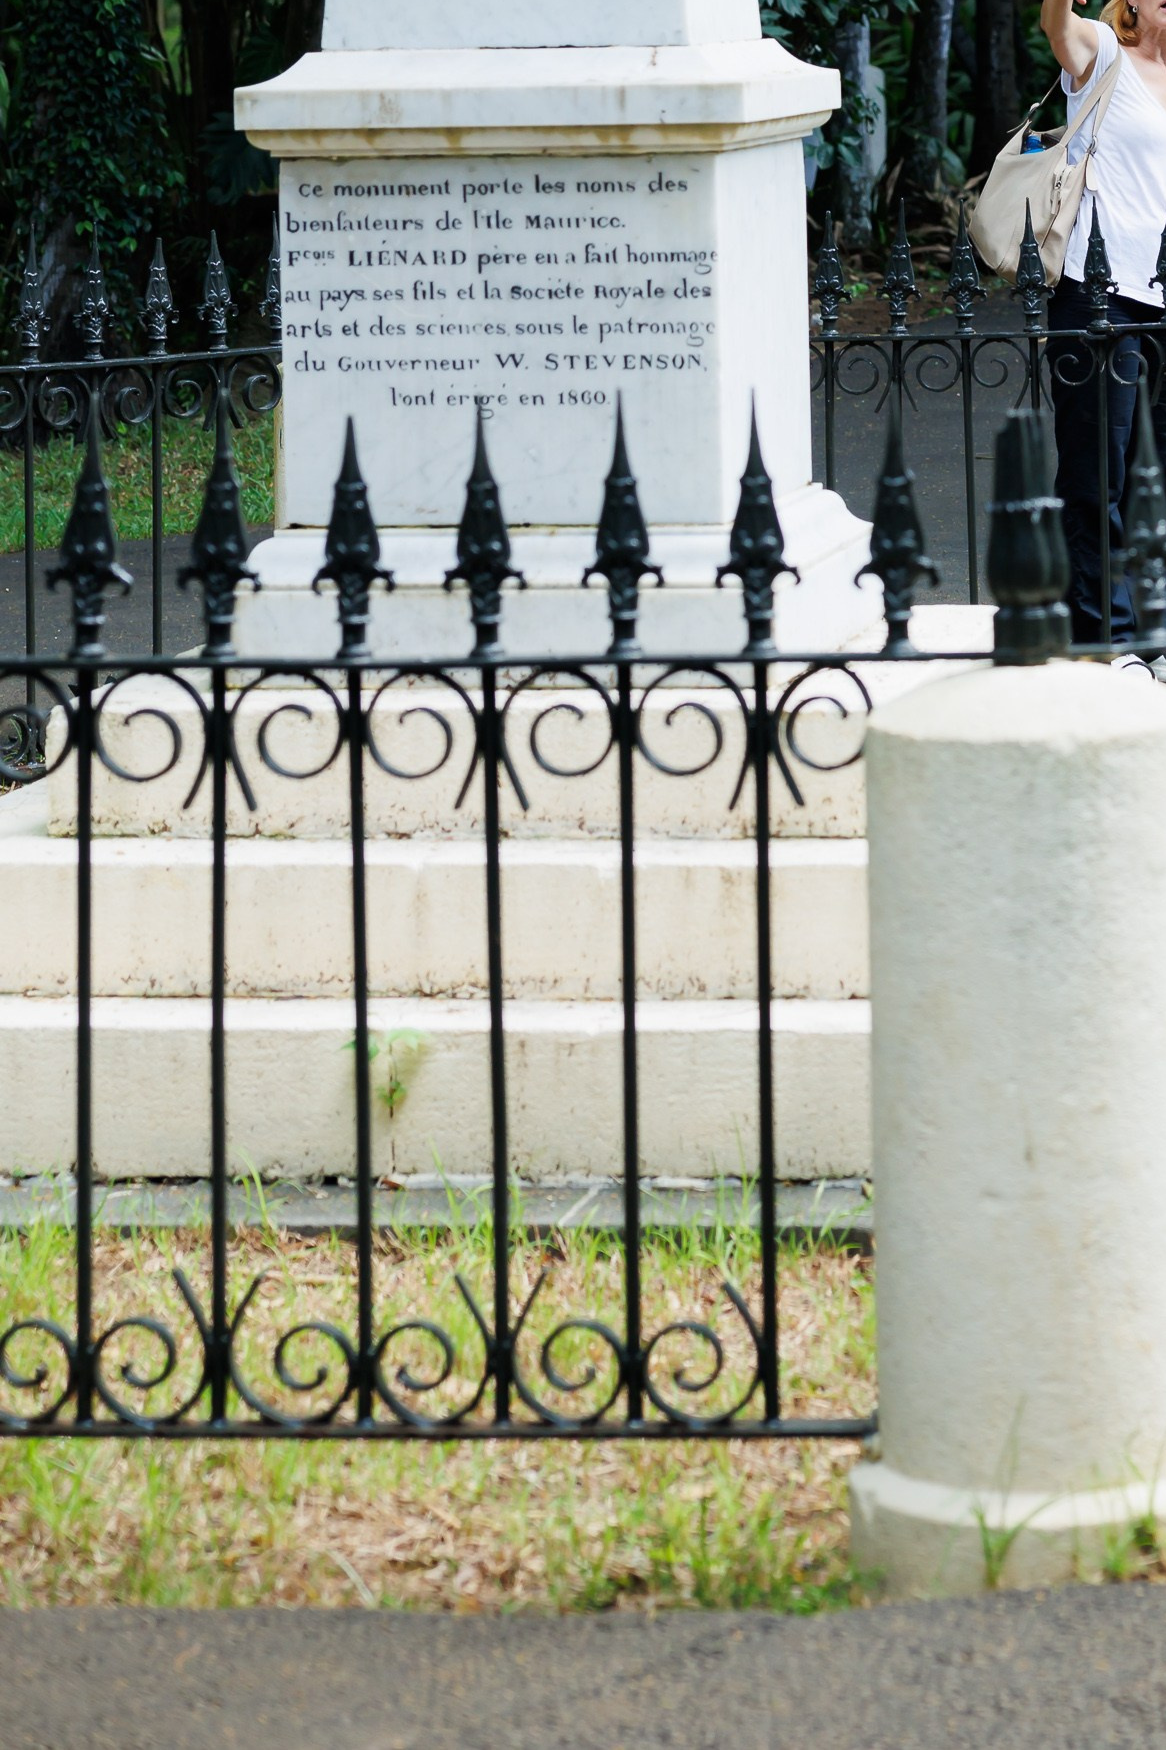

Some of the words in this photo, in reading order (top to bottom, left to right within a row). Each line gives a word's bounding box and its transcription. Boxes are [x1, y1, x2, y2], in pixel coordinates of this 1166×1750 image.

[333, 178, 451, 197] monument
[462, 178, 523, 203] porte
[534, 174, 565, 194] les
[576, 178, 636, 194] noms
[648, 171, 688, 194] des
[285, 210, 424, 233] bienfaiteurs
[435, 210, 463, 231] de
[348, 240, 467, 267] LIÉNARD
[535, 251, 559, 265] en
[565, 251, 576, 265] a
[584, 243, 620, 265] fait
[625, 243, 719, 276] hommage
[285, 289, 311, 303] au
[372, 289, 404, 301] ses
[412, 279, 447, 301] fils
[457, 282, 476, 300] et
[483, 280, 502, 300] la
[594, 279, 665, 308] Royale
[673, 277, 712, 299] des
[286, 318, 332, 338] arts
[341, 318, 360, 337] et
[369, 315, 406, 336] des
[515, 322, 564, 335] sous
[573, 315, 589, 335] le
[599, 317, 715, 347] patronage
[294, 350, 326, 372] du
[338, 355, 480, 372] Gouverneur
[495, 353, 529, 369] W.
[519, 393, 545, 405] en
